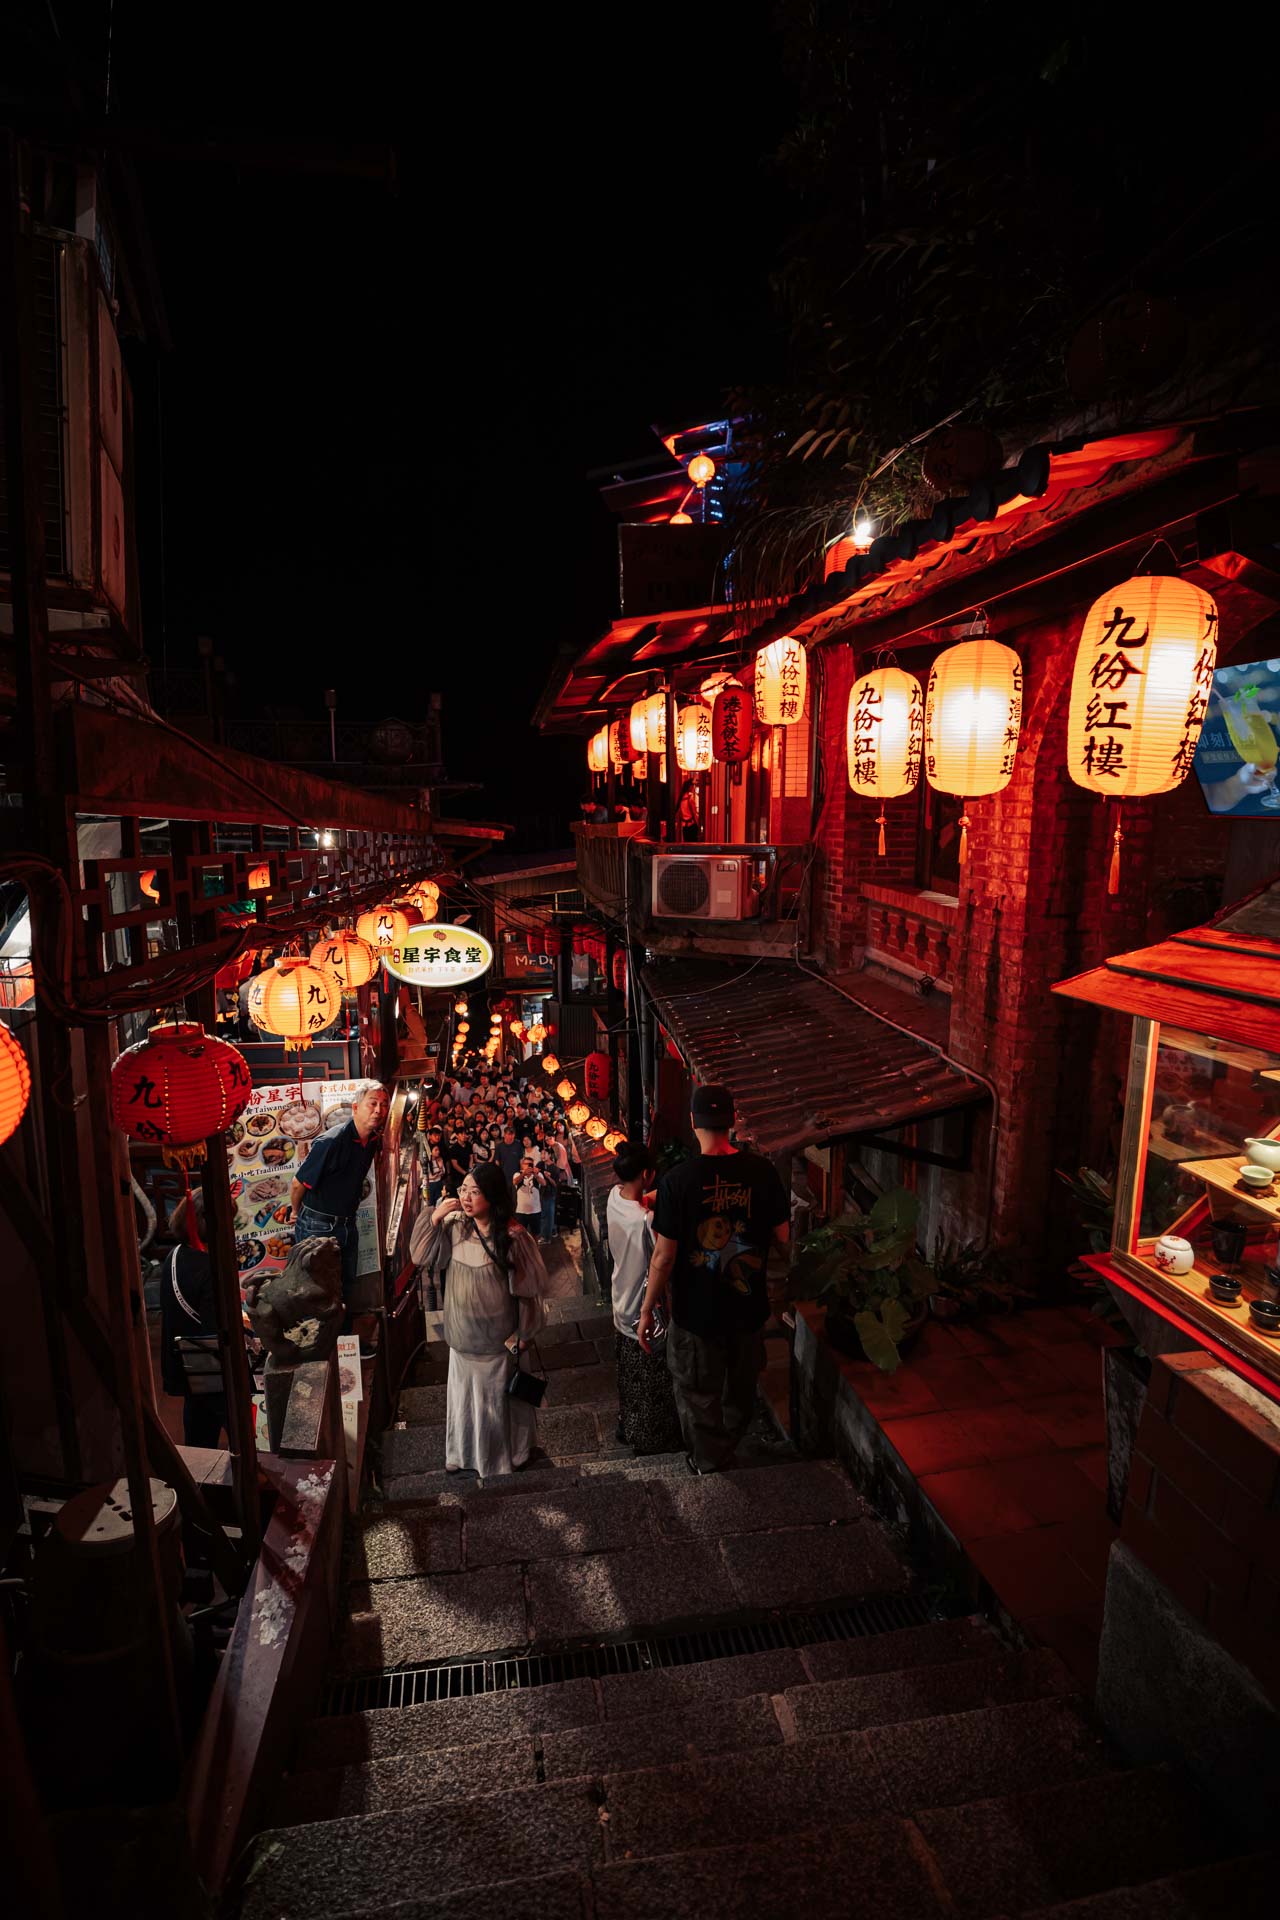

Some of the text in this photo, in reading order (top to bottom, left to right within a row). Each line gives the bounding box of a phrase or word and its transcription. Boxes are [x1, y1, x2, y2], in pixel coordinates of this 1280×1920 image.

[720, 696, 742, 757] 港式飲茶
[378, 915, 393, 945] 九份
[402, 947, 481, 963] 星宇食堂
[307, 984, 327, 1030] 九份
[128, 1075, 173, 1142] 九份
[256, 1163, 295, 1176] Traditional
